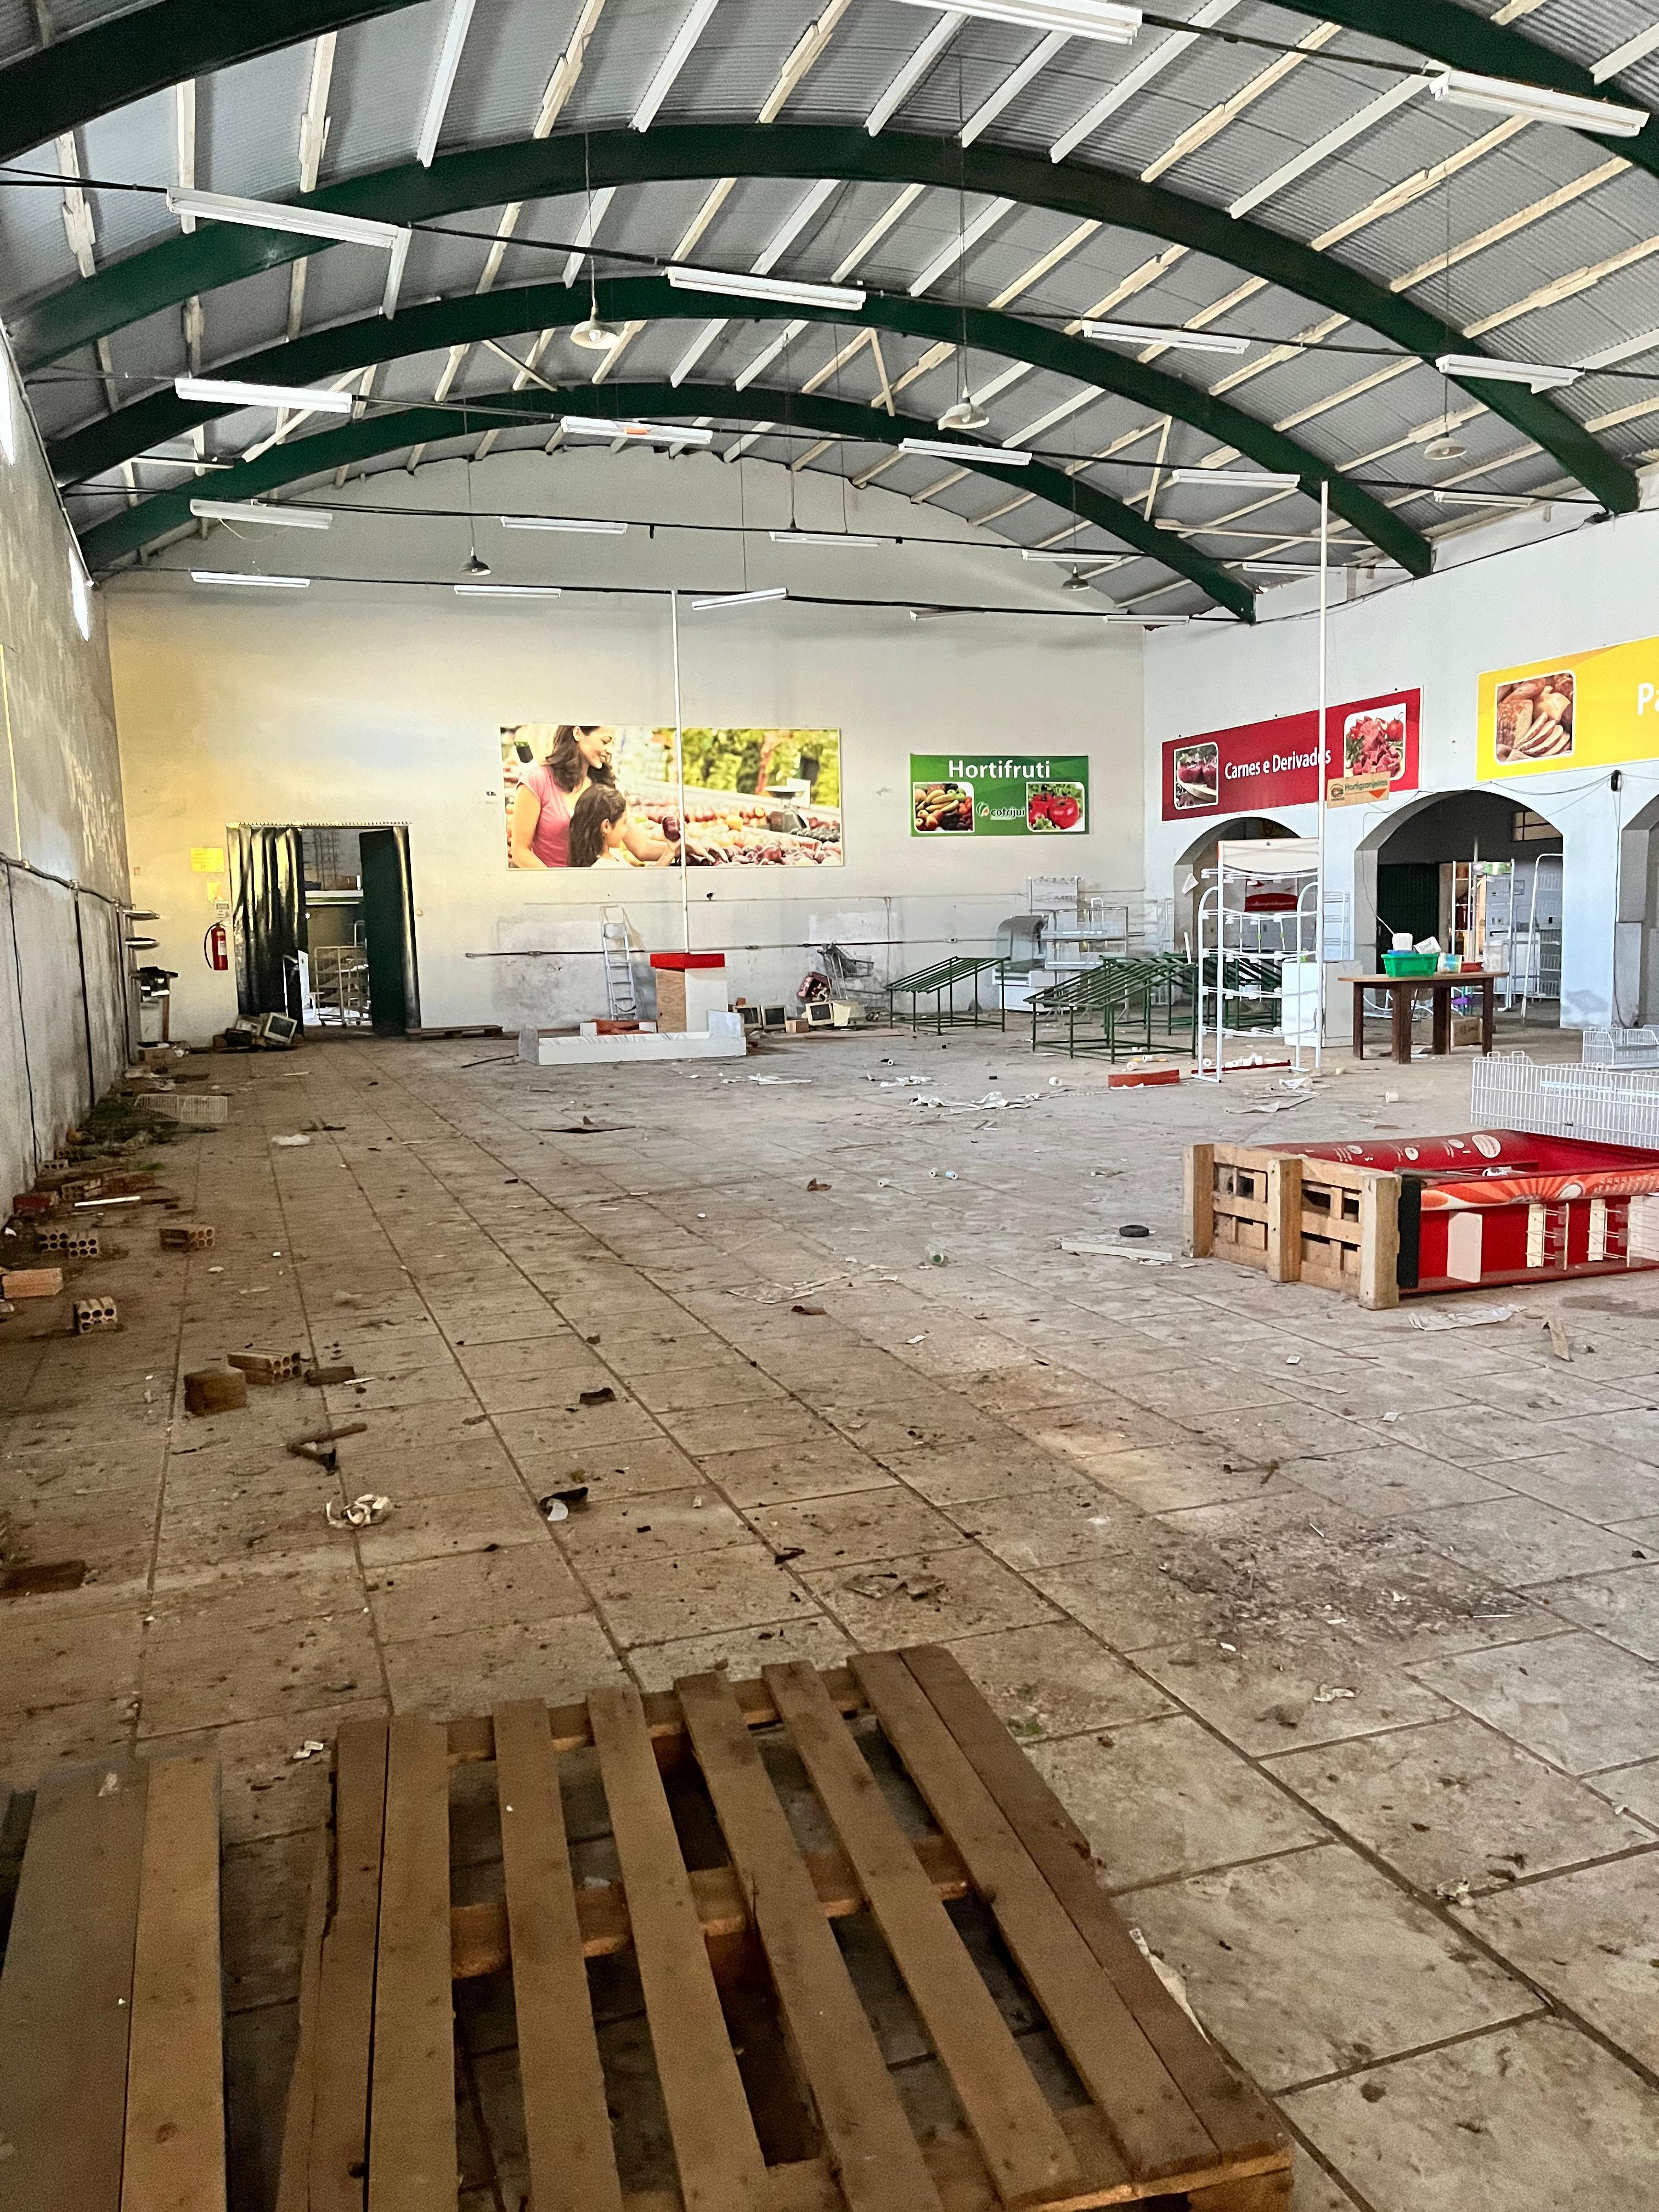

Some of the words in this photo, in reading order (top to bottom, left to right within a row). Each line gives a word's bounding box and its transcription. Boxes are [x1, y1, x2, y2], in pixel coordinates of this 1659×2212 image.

[948, 759, 1051, 778] Hortifruti
[1224, 761, 1261, 780] Carnes
[1263, 760, 1270, 774] e
[1272, 746, 1331, 772] Derivads
